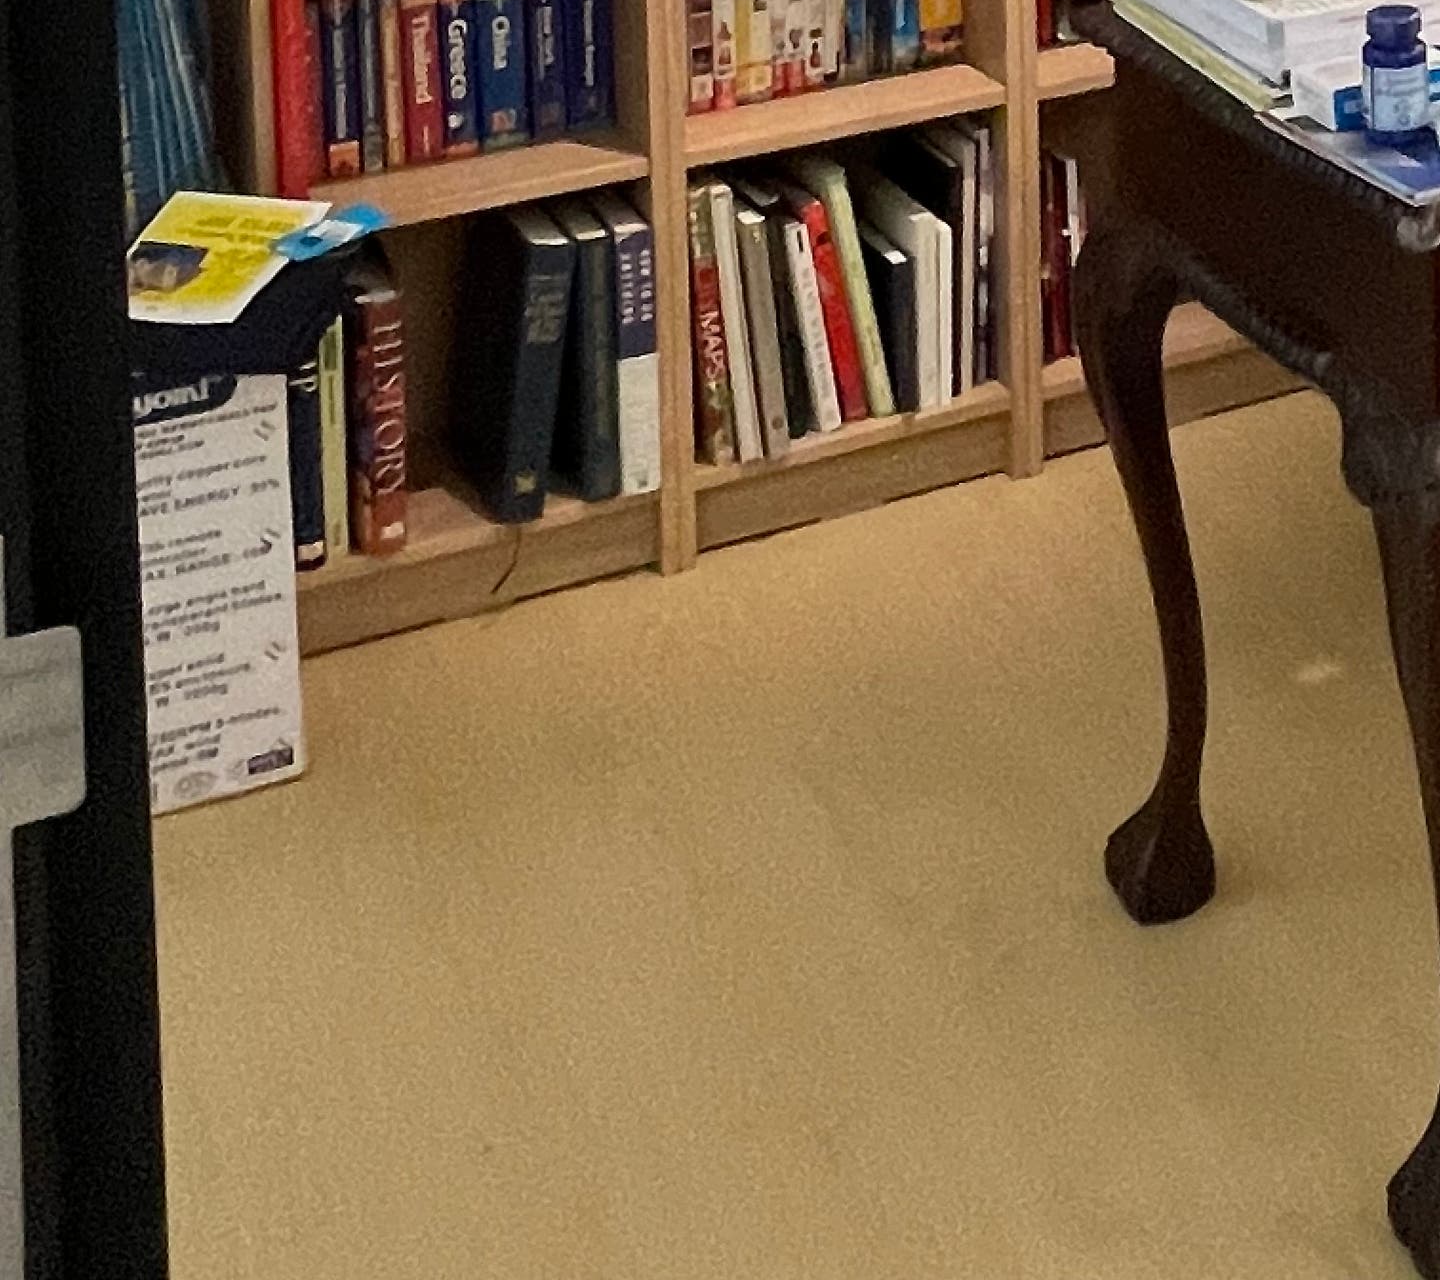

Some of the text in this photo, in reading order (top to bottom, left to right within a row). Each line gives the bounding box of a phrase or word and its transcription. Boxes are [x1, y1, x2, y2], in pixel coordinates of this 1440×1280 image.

[411, 15, 432, 105] Thailand
[448, 18, 467, 100] Greece
[700, 309, 726, 380] MAPS
[373, 320, 405, 496] HISTORY
